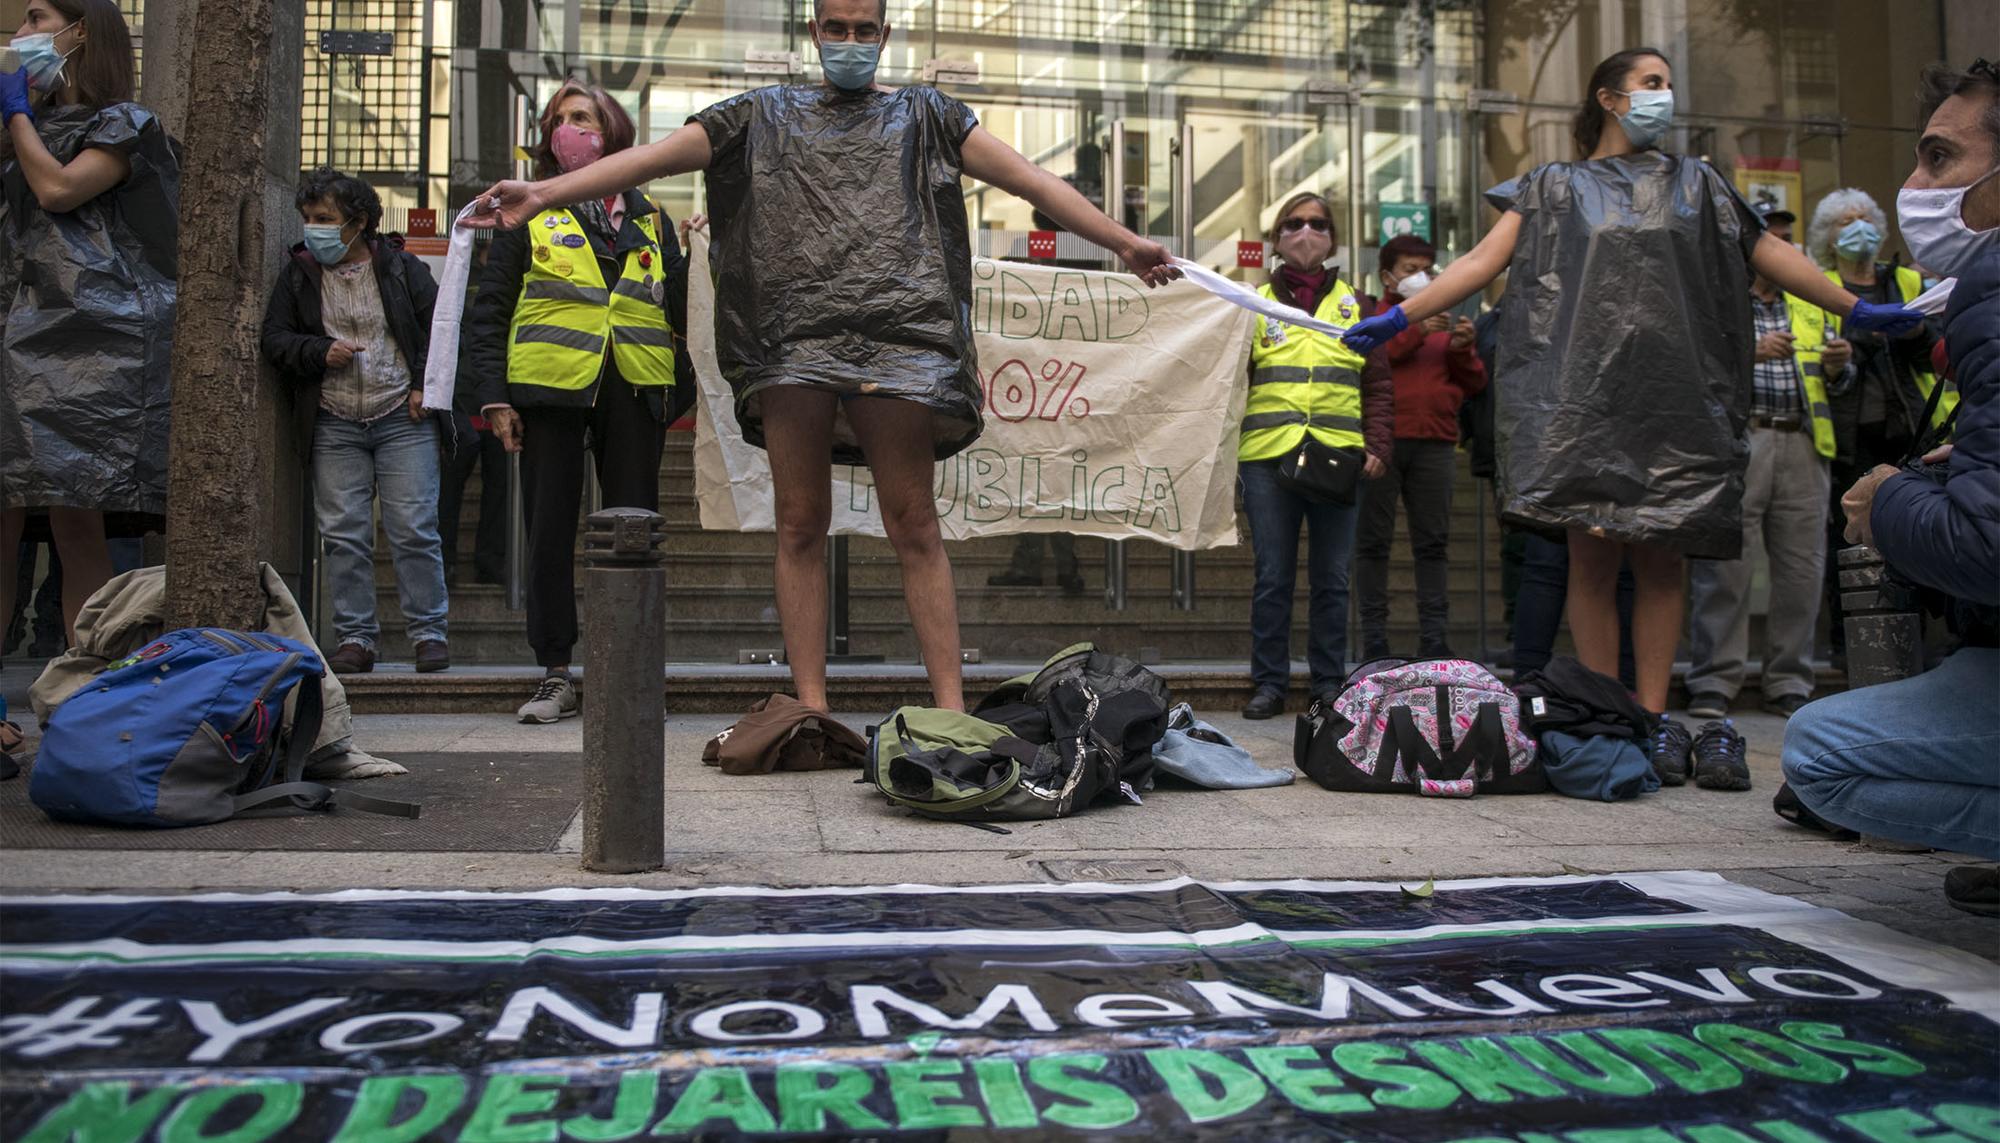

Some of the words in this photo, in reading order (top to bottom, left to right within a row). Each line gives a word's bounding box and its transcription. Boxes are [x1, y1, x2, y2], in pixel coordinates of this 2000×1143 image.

[976, 358, 1090, 423] 0%
[0, 964, 1883, 1061] #YoNoMeMuevo
[16, 1078, 305, 1143] NO
[1145, 1020, 1926, 1123] DESNUDOS
